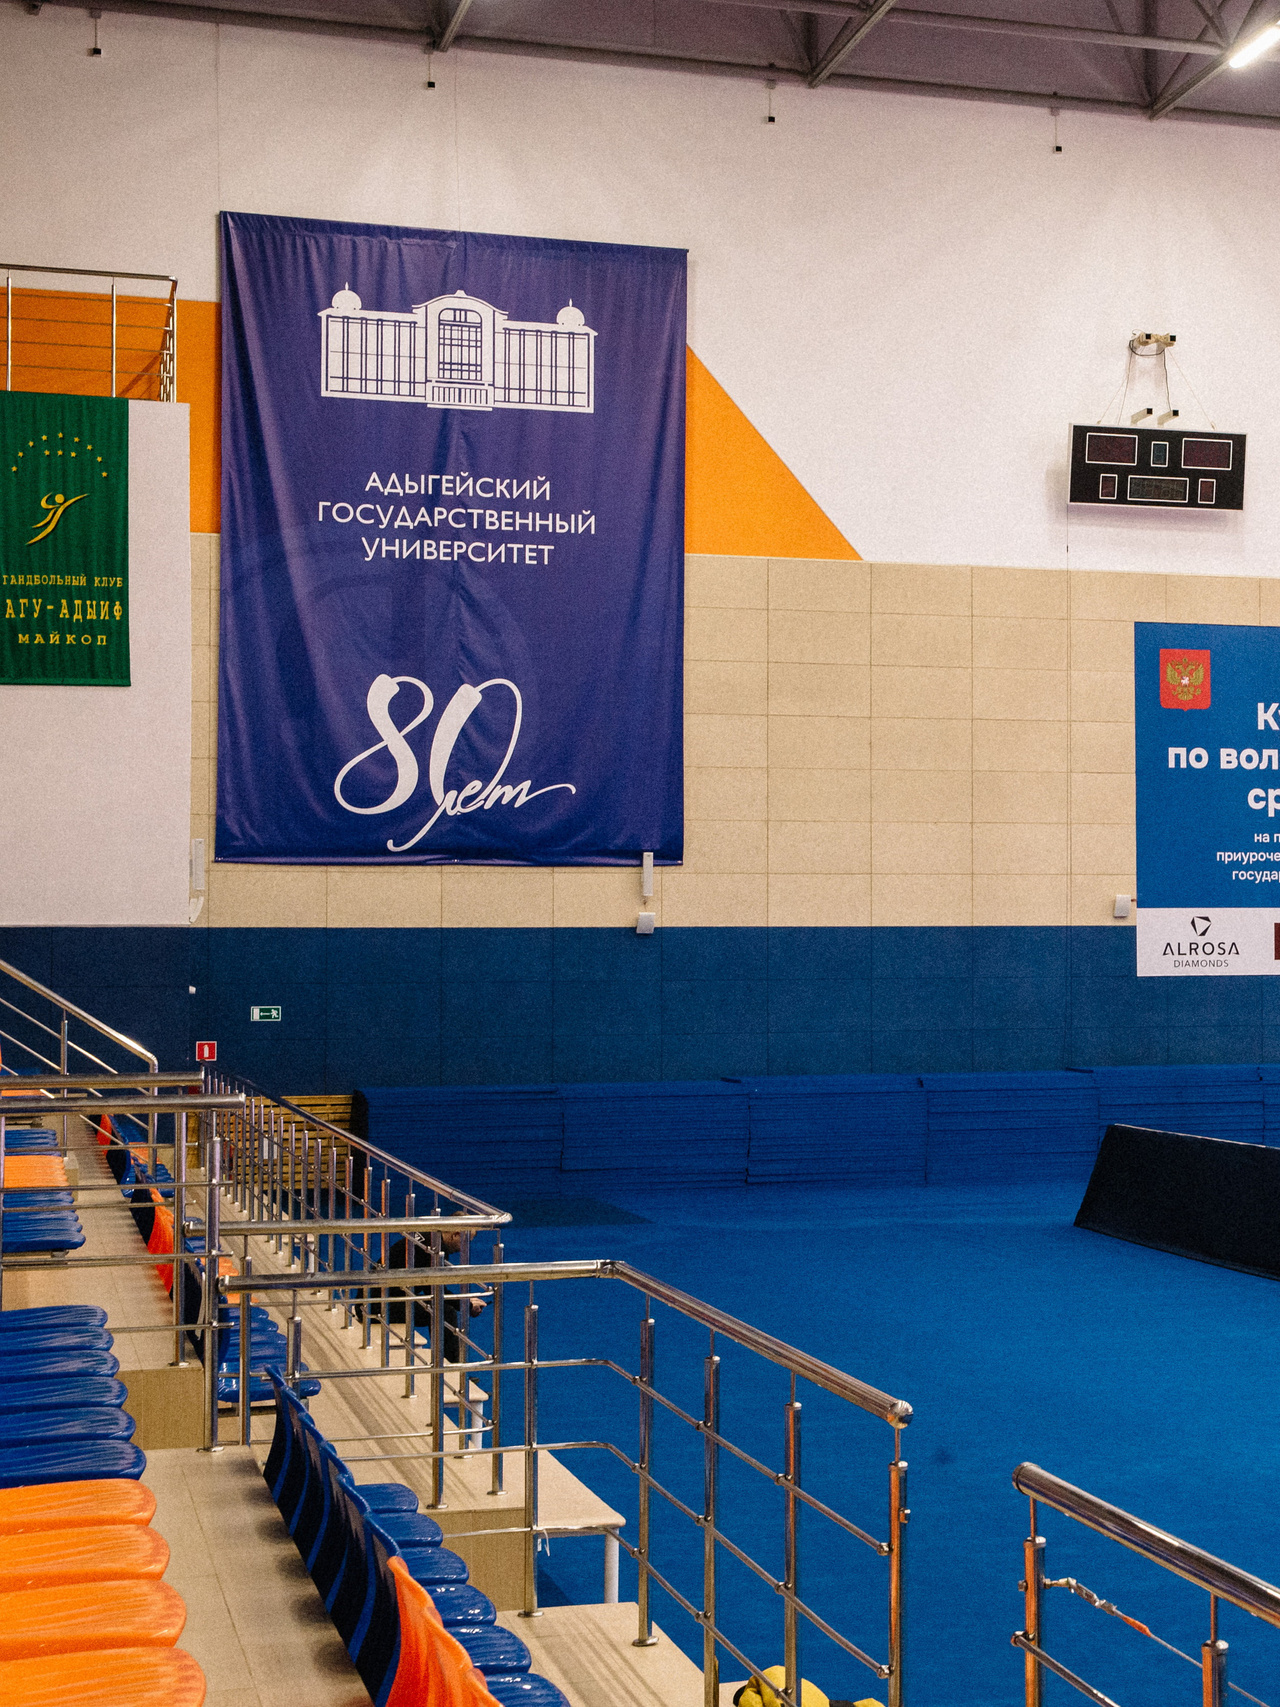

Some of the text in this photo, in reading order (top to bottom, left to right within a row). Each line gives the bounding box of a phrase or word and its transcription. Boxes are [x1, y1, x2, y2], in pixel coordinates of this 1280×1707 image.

[365, 471, 550, 500] АДЫГЕЙСКИЙ
[318, 501, 596, 535] ГОСУДАРСТВЕННЫЙ
[361, 537, 555, 565] УНИВЕРСИТЕТ
[2, 573, 124, 588] ГАНДБОЛЬНЫЙ КЛУБ
[5, 598, 123, 622] АГУ-АДЫИФ
[18, 631, 107, 645] МАЙКОП
[334, 673, 522, 815] 80
[1168, 746, 1209, 769] по
[1254, 833, 1270, 844] на
[1162, 941, 1240, 957] ALROSA
[1173, 959, 1229, 968] DIAMONDS
